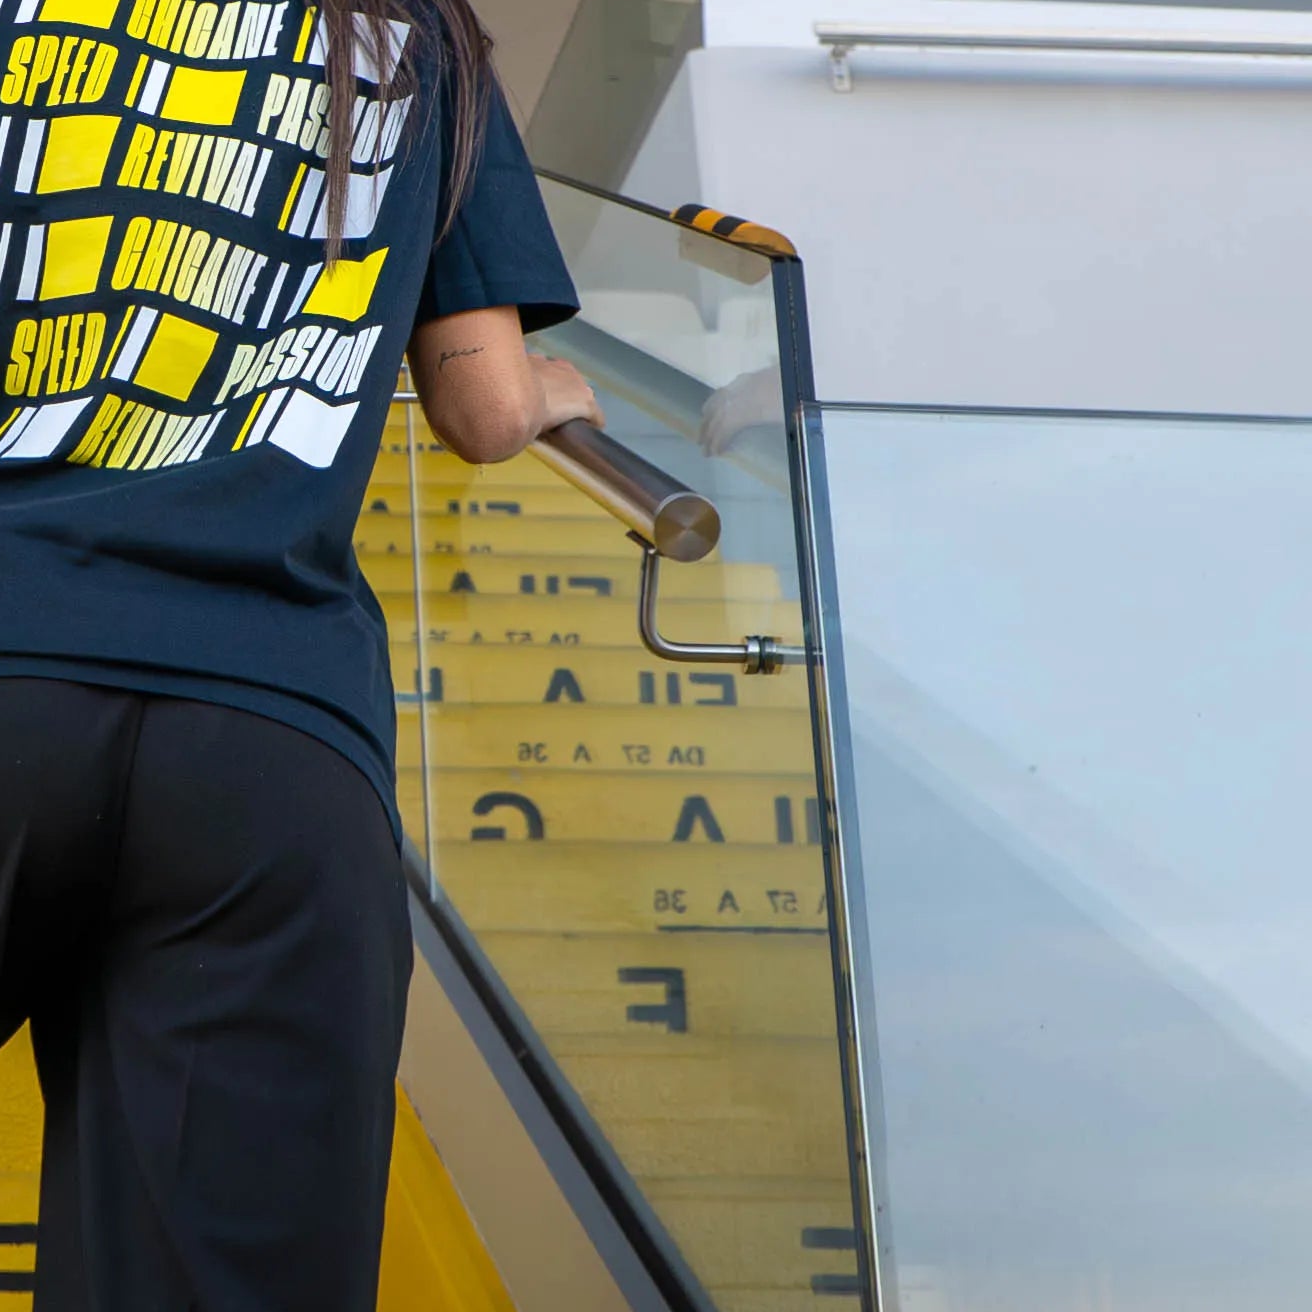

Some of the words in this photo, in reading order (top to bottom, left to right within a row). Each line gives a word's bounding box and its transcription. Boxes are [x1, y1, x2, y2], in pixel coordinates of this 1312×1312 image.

[0, 36, 118, 106] SPEED
[117, 126, 273, 218] REVIVAL
[111, 216, 268, 325] CHICANE
[5, 312, 106, 397] SPEED
[213, 324, 382, 405] PASSION
[67, 394, 227, 470] REVIVAL
